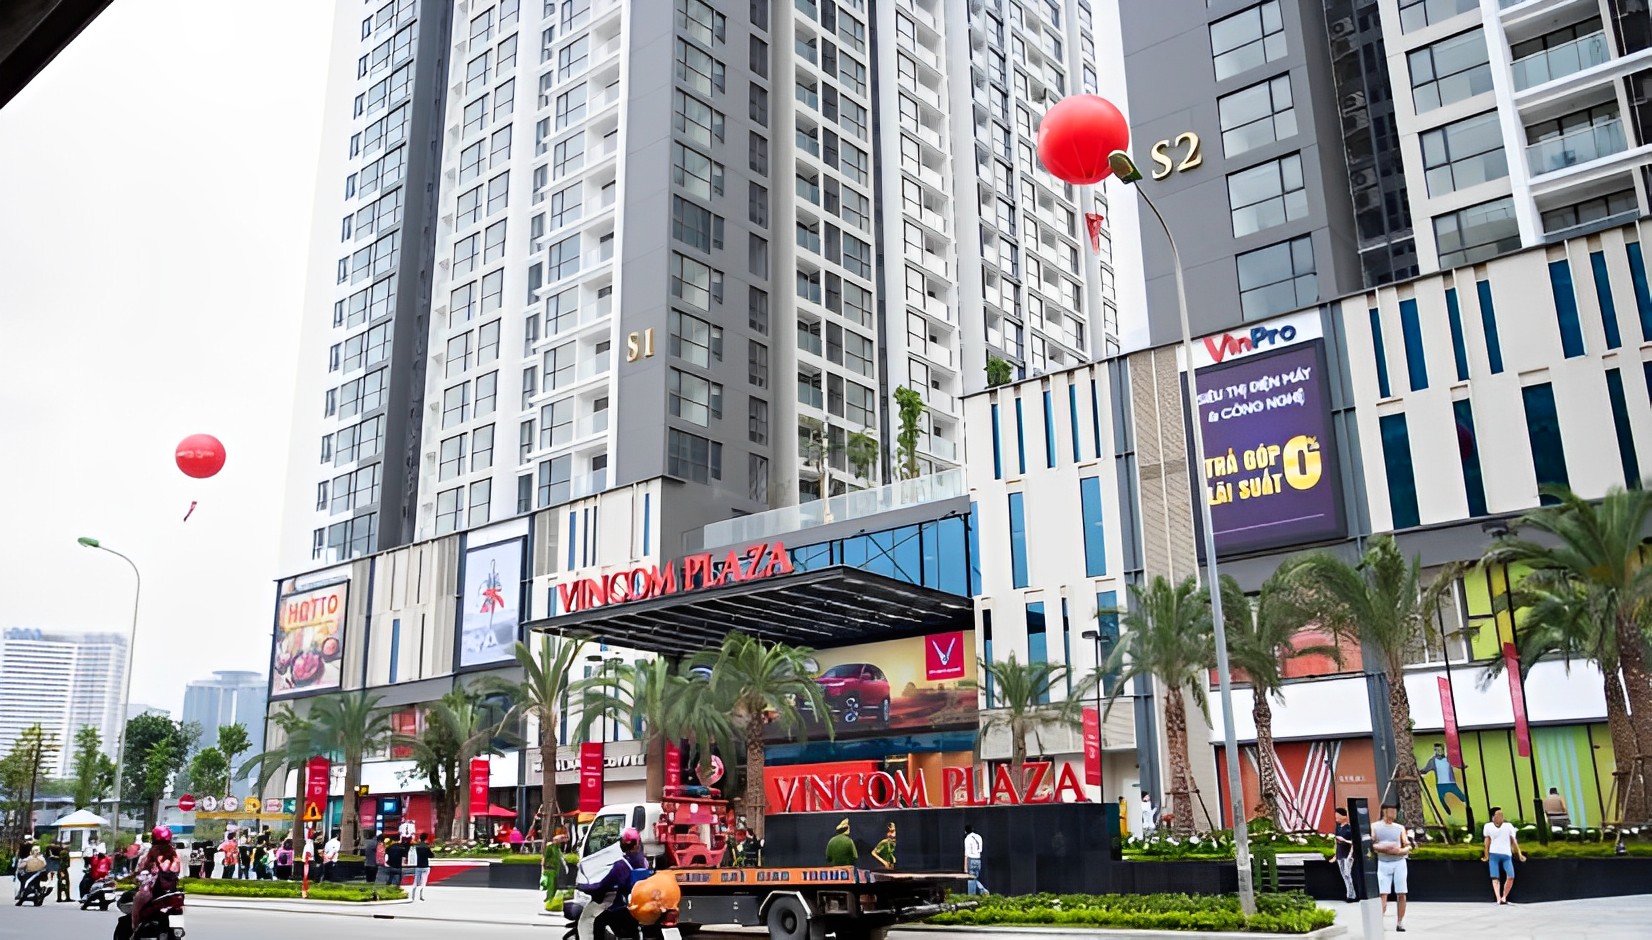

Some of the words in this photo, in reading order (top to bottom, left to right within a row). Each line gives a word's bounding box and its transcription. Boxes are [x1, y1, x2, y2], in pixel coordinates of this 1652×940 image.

[1150, 131, 1202, 181] S2
[626, 327, 655, 363] S1
[1203, 325, 1297, 363] VinPro
[1243, 443, 1281, 471] GÓP
[557, 560, 678, 614] VINCOM
[683, 541, 795, 592] PLAZA
[773, 767, 930, 813] VINCOM
[942, 761, 1088, 807] PLAZA
